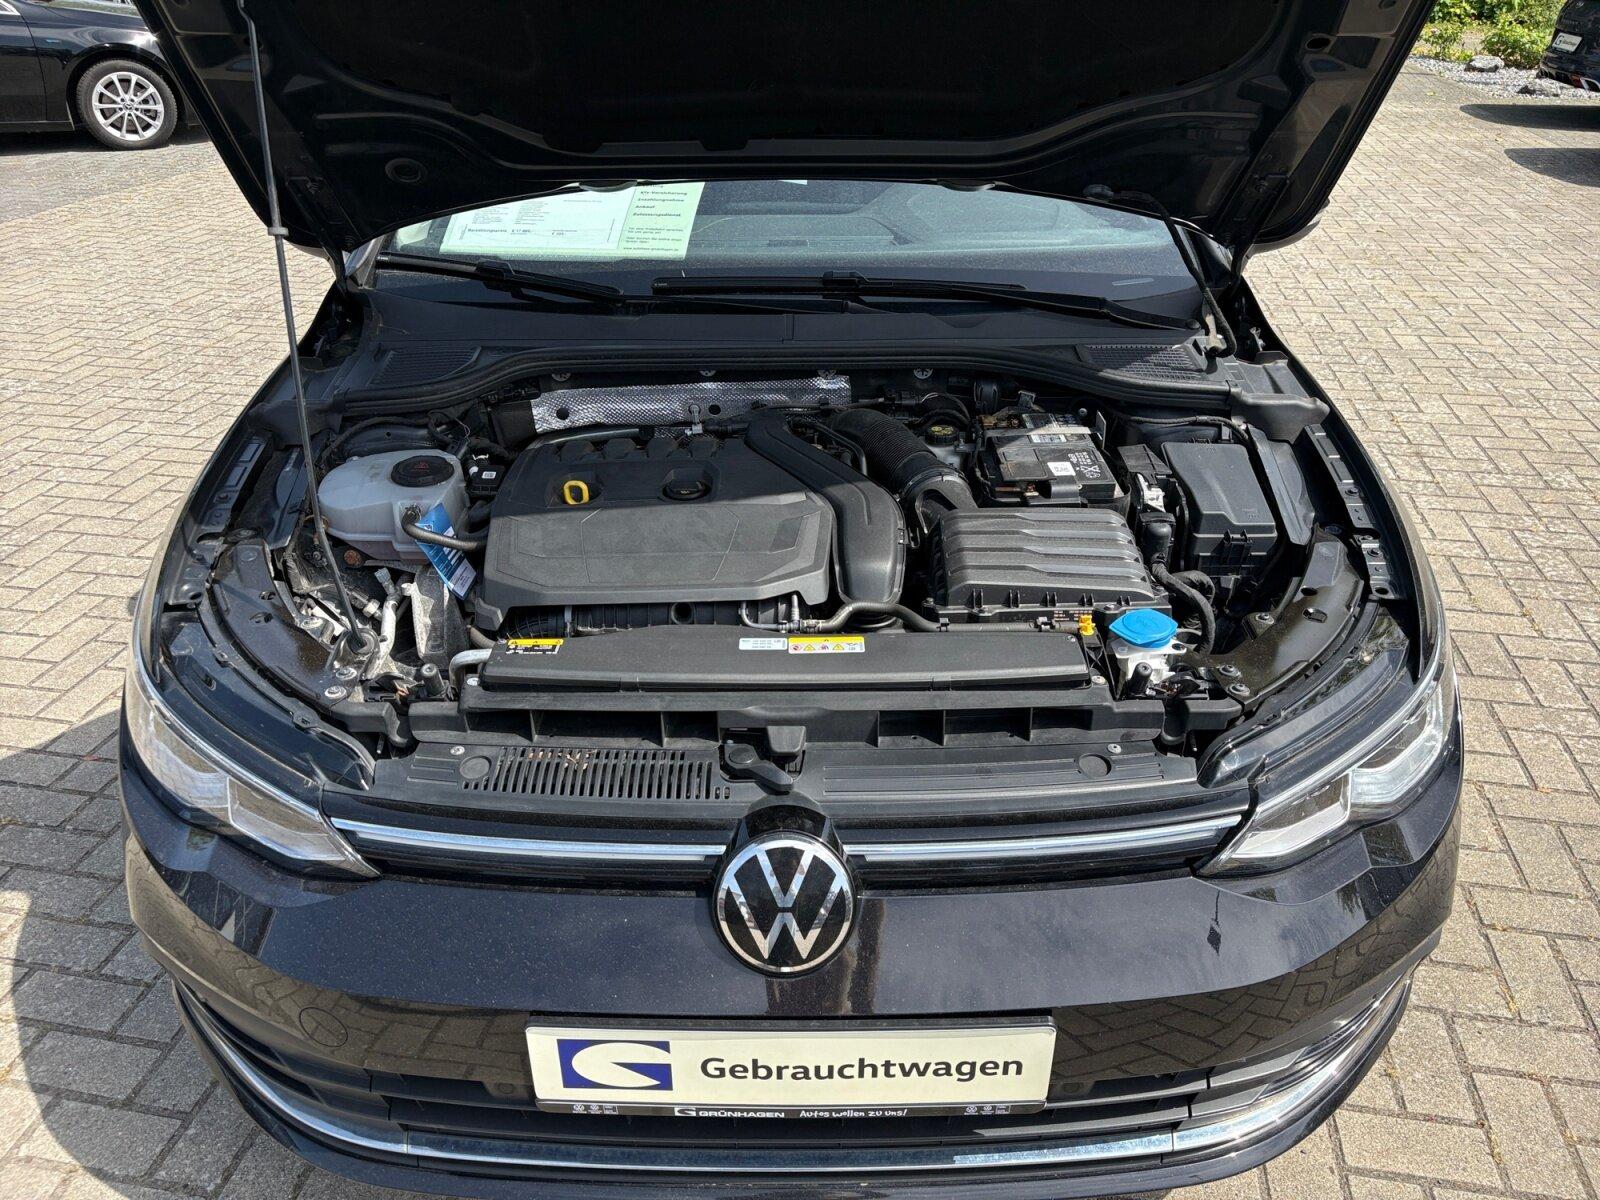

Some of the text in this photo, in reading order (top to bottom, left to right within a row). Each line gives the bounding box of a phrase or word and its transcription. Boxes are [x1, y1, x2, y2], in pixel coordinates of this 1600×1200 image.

[700, 1057, 1023, 1082] Gebrauchtwagen
[698, 1110, 785, 1118] GRÜNHAGEN
[799, 1109, 830, 1118] Autos
[832, 1109, 866, 1118] wollen
